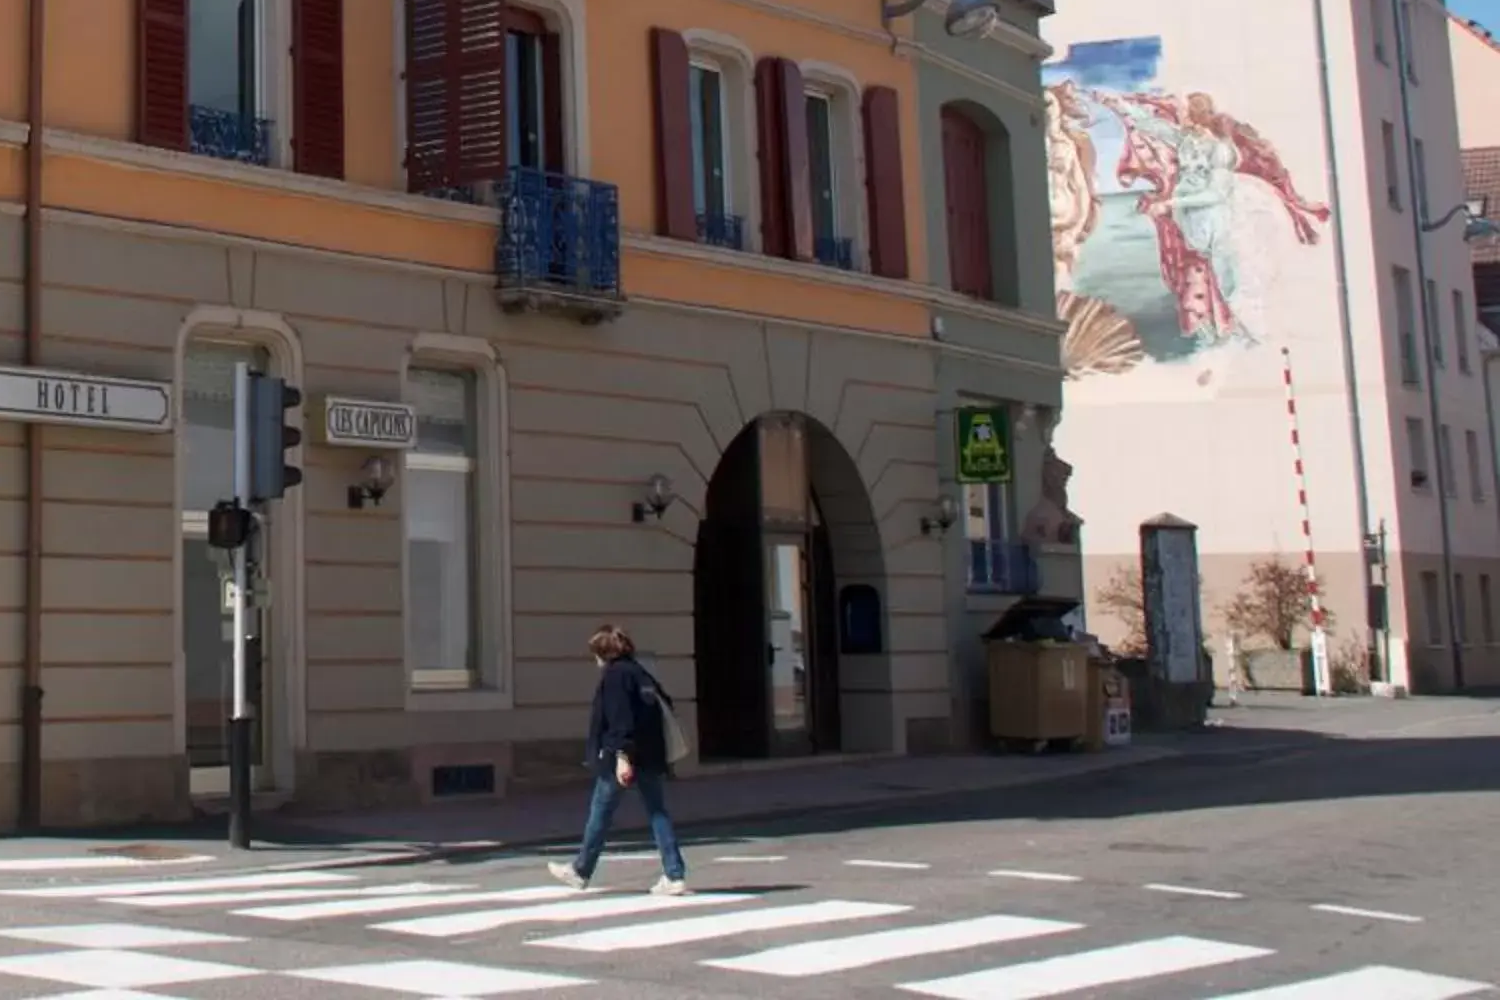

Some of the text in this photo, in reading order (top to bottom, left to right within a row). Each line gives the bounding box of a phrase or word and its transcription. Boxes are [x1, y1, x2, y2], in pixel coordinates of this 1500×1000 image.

[36, 379, 111, 415] HOTEL
[334, 407, 408, 437] LES CAPUCINS
